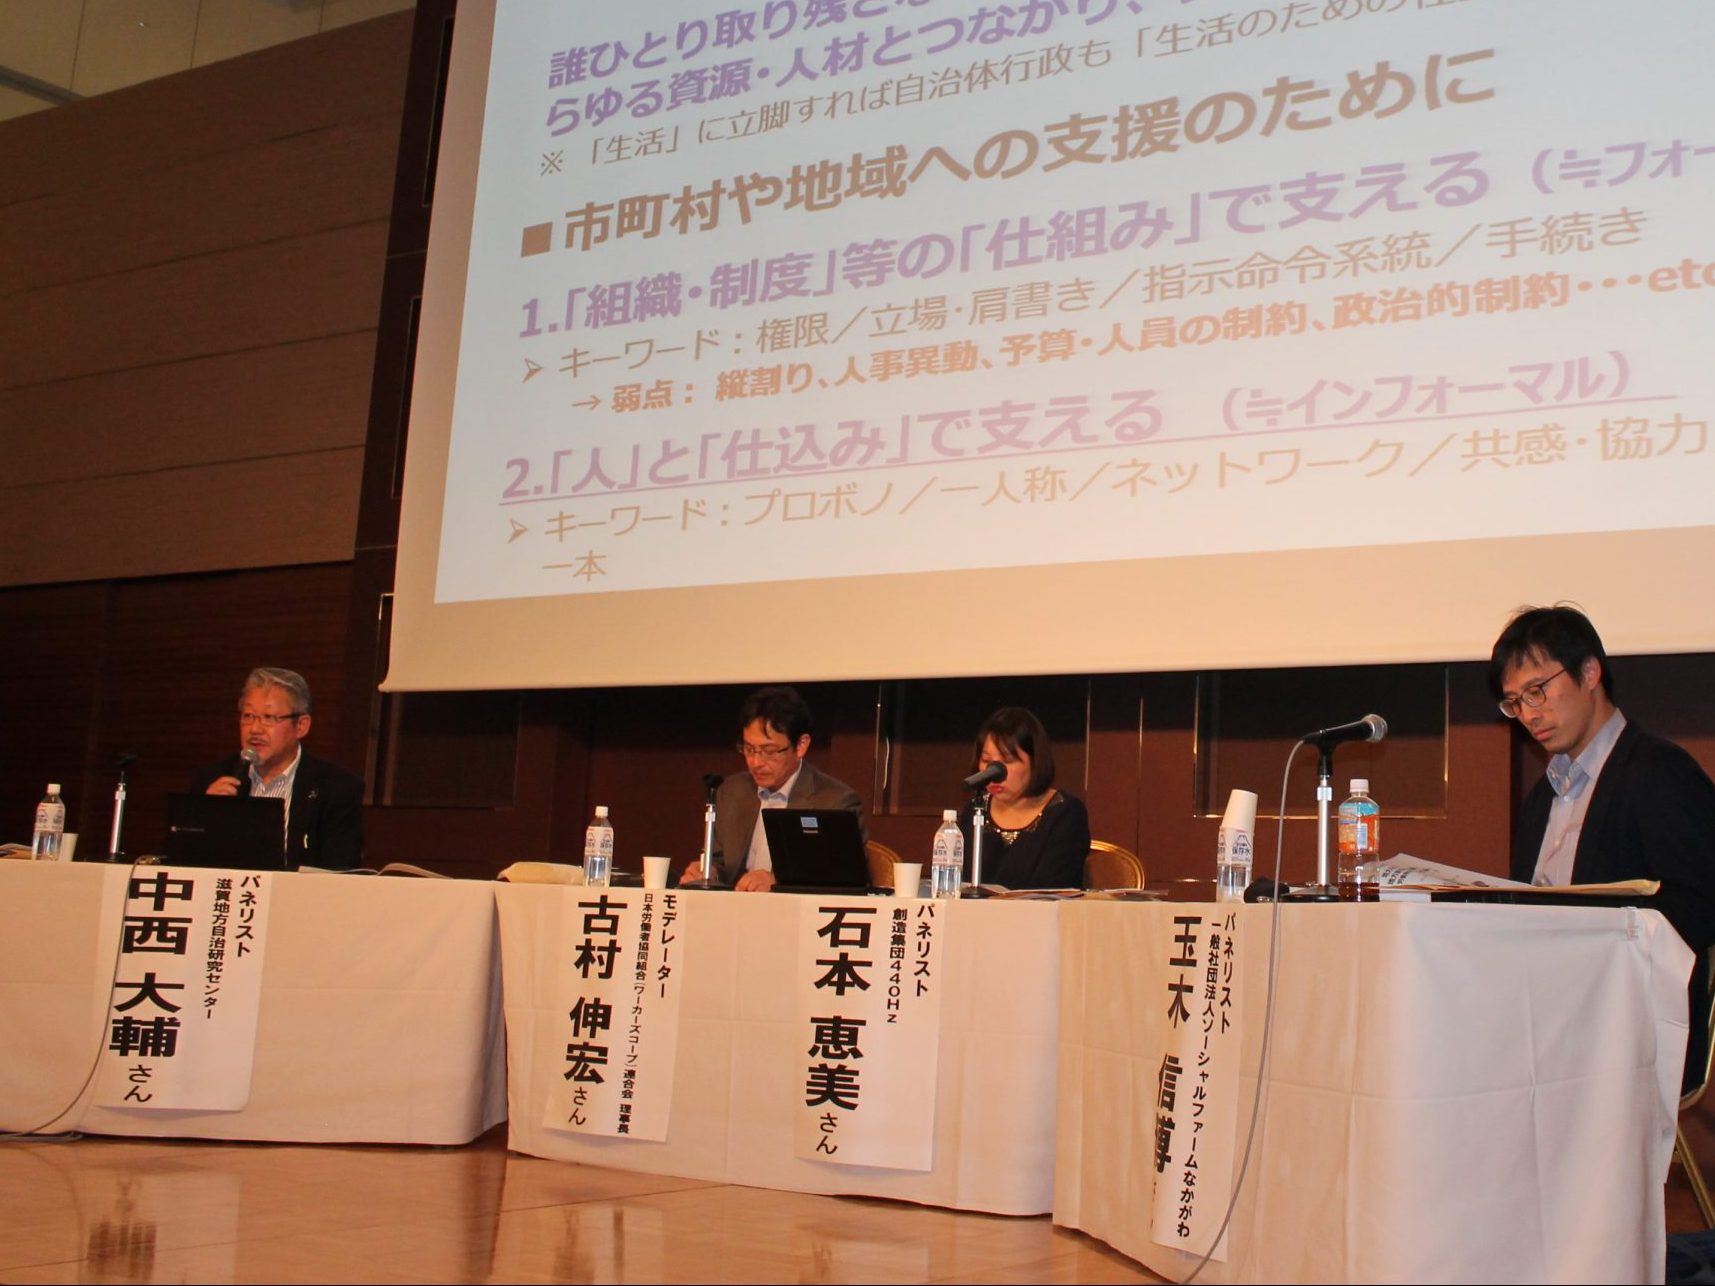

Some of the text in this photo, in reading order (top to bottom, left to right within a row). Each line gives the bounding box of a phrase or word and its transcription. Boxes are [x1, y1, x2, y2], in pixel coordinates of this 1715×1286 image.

[544, 0, 1196, 137] らゆる資源・人材とつながり、
[548, 0, 931, 88] 誰ひとり取り残
[204, 878, 232, 1019] 滋賀地方自治研究センター
[236, 875, 261, 957] パネリスト
[657, 895, 677, 998] モデレーター
[914, 903, 935, 997] パネリスト
[1220, 912, 1236, 1034] パネリスト
